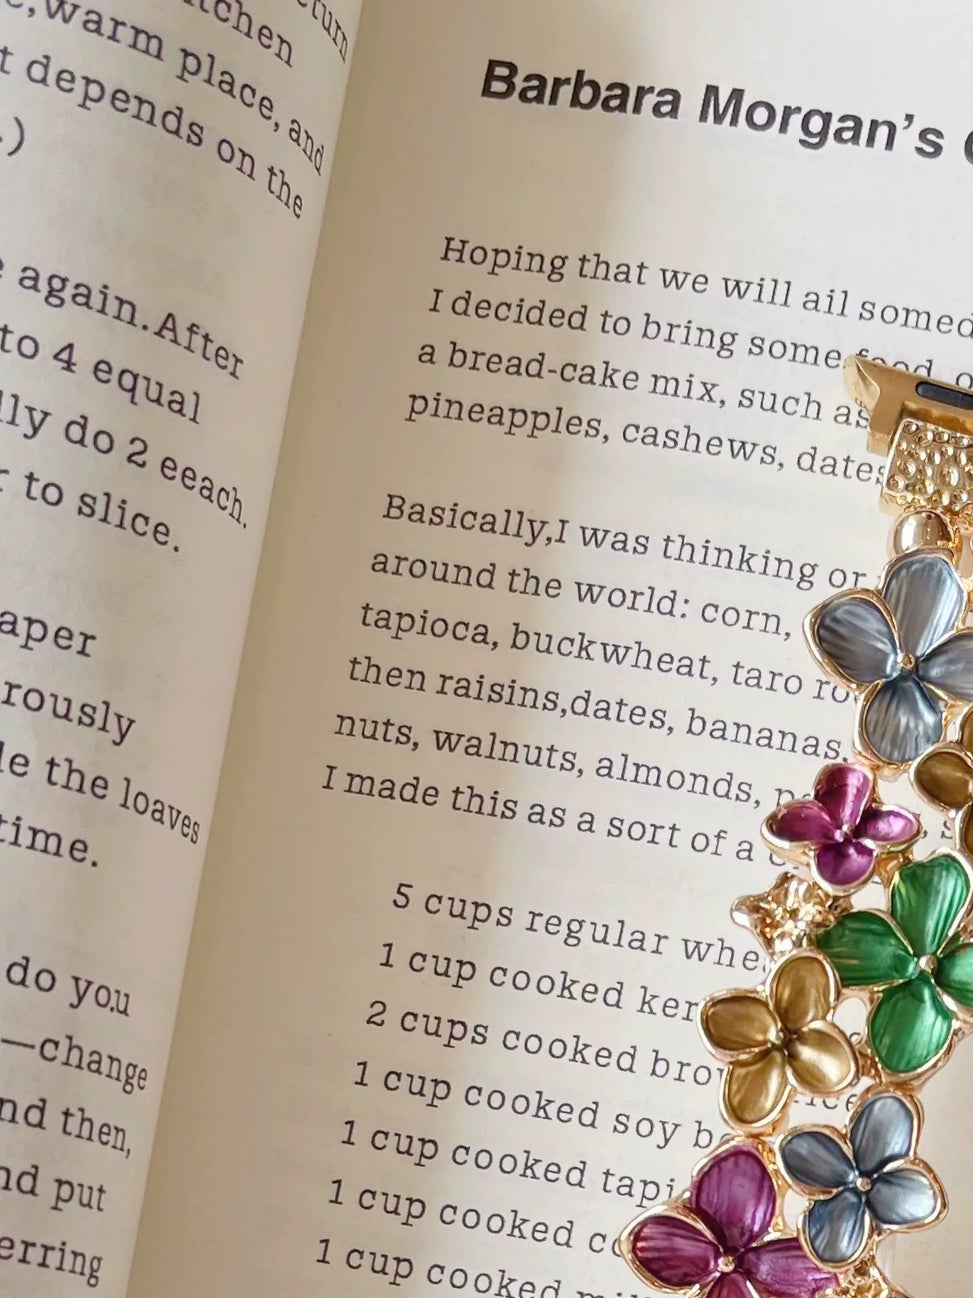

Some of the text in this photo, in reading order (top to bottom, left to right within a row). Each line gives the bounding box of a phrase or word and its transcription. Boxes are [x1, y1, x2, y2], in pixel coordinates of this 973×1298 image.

[175, 47, 325, 177] place, and
[480, 58, 682, 120] Barbara
[25, 54, 303, 220] depends on the
[439, 235, 570, 283] Hoping
[578, 252, 650, 286] that
[659, 267, 709, 294] we
[721, 276, 792, 309] will
[802, 288, 849, 318] ail
[428, 288, 444, 313] I
[450, 289, 589, 332] decided
[599, 309, 632, 336] to
[641, 312, 740, 360] bring
[747, 335, 842, 370] some
[52, 342, 201, 425] 4 equal
[417, 340, 870, 430] a bread-cake mix, such as
[64, 414, 248, 530] do 2 eeach.
[404, 391, 785, 472] pineapples, cashews,
[23, 471, 180, 553] to slice.
[370, 552, 792, 642] around the world: corn,
[578, 525, 650, 556] was
[662, 533, 820, 592] thinking
[348, 655, 426, 693] then
[360, 602, 803, 696] tapioca, buckwheat, taro
[45, 756, 201, 845] the loaves
[333, 713, 762, 809] nuts, walnuts, almonds,
[343, 770, 441, 808] made
[451, 785, 519, 820] this
[527, 802, 567, 828] as
[576, 811, 596, 834] a
[606, 816, 682, 849] sort
[690, 829, 728, 857] of
[735, 839, 754, 863] a
[392, 882, 670, 956] 5 cups regular
[5, 955, 57, 993] do
[379, 942, 625, 1010] 1 cup cooked
[365, 1000, 638, 1074] 2 cups cooked
[60, 1106, 131, 1159] then,
[464, 1085, 683, 1150] cooked soy
[50, 1178, 107, 1213] put
[345, 1247, 414, 1287] cup
